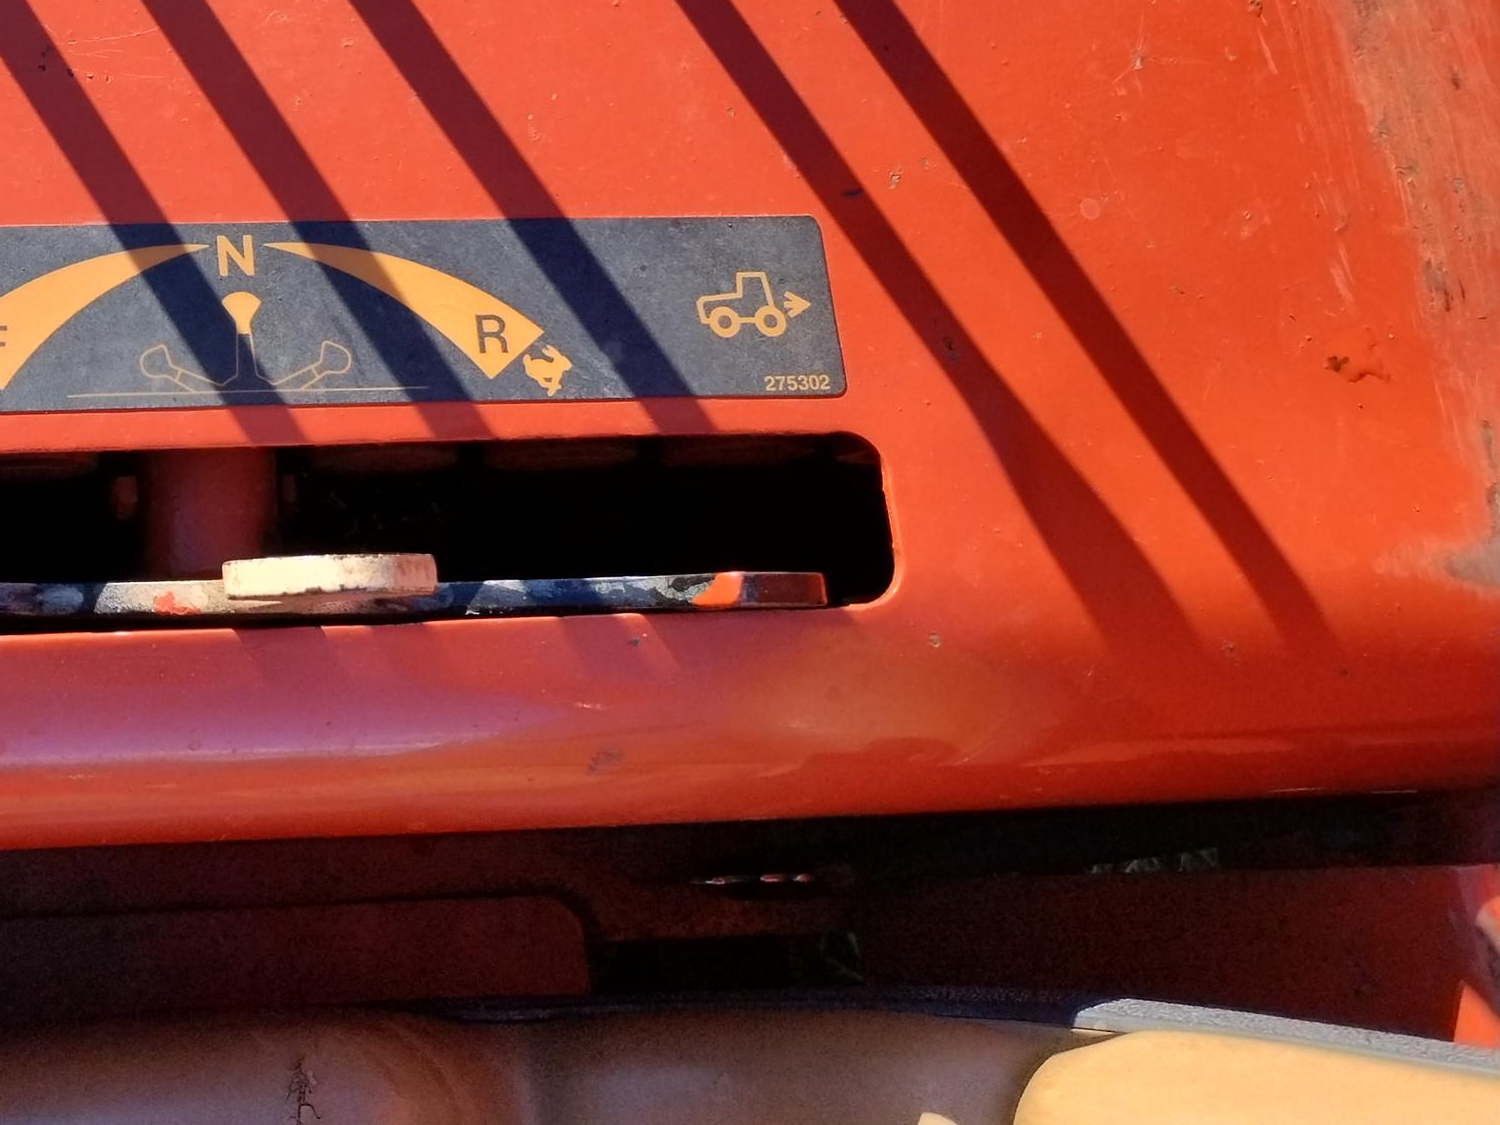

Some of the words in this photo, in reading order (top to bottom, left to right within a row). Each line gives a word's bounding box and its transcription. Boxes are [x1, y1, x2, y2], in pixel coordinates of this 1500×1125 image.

[215, 235, 255, 277] N
[473, 313, 511, 355] R
[763, 374, 831, 392] 275302
